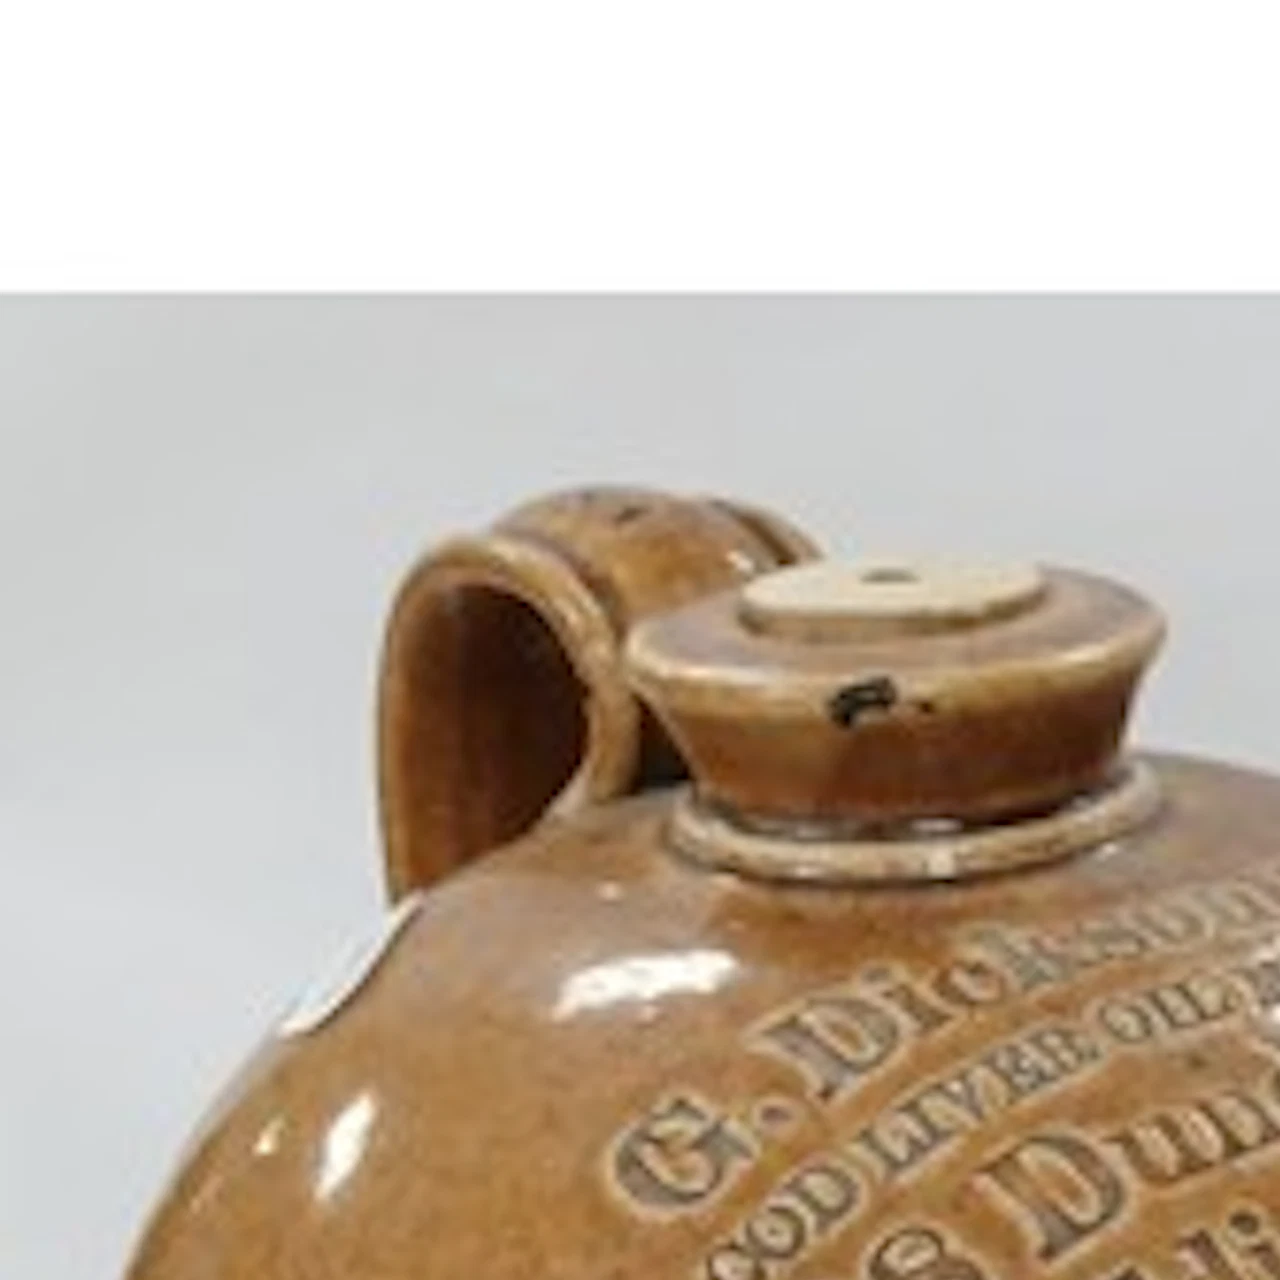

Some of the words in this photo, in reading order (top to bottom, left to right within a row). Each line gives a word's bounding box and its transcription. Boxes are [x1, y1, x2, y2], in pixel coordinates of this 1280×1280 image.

[610, 1092, 795, 1212] G.
[755, 872, 1272, 1105] Dickson
[862, 1022, 1102, 1182] LIVER
